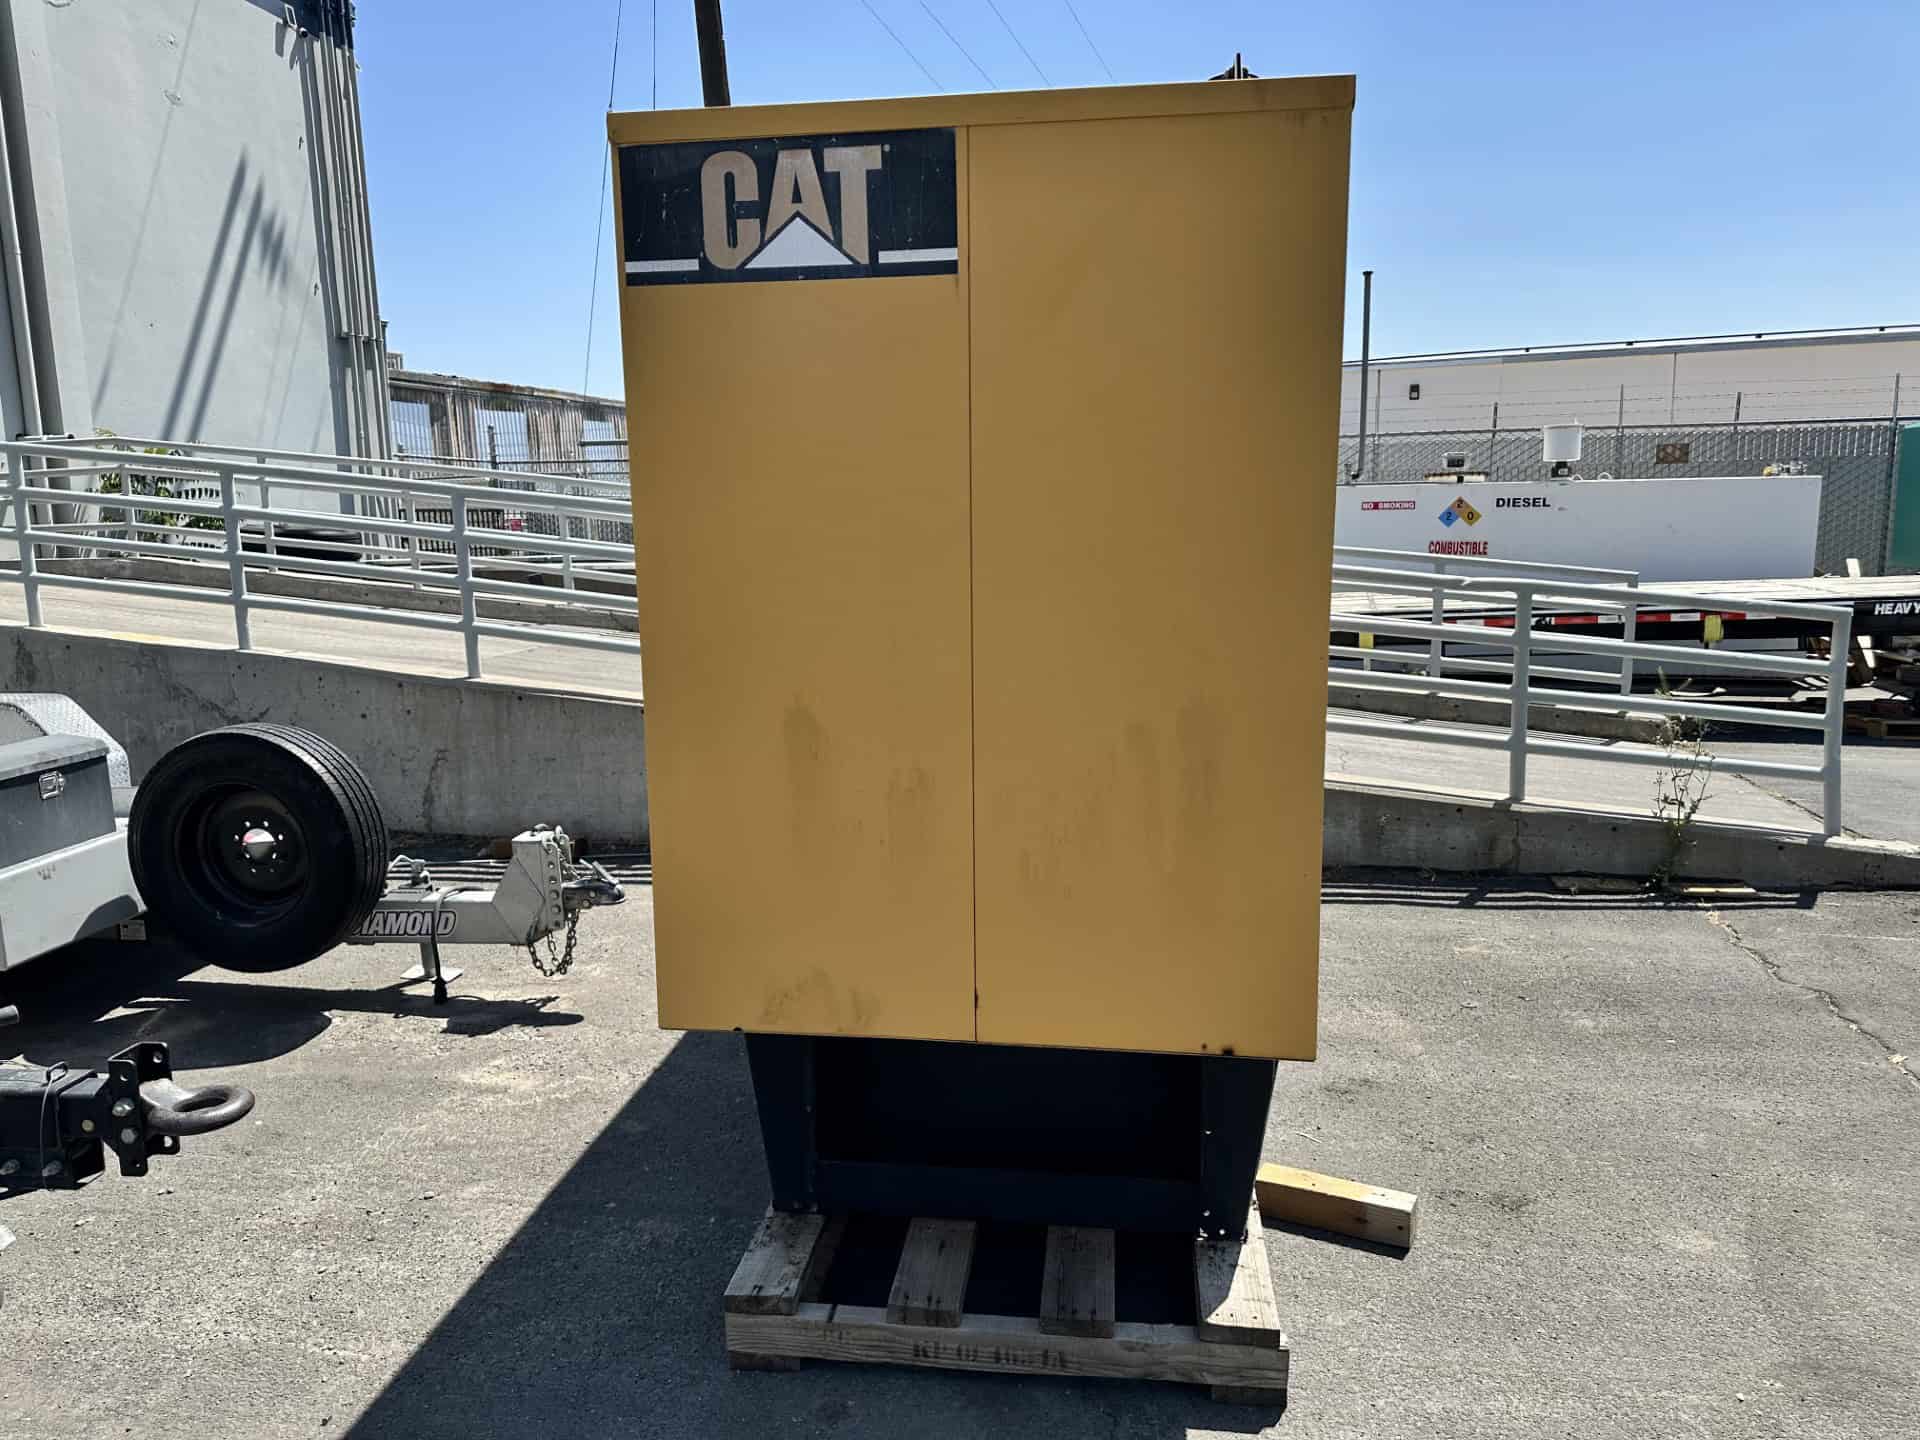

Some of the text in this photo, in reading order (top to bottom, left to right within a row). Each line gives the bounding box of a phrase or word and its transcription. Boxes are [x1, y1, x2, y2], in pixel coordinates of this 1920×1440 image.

[701, 144, 882, 270] CAT
[1495, 497, 1551, 508] DIESEL
[1445, 511, 1453, 521] 2
[1467, 511, 1474, 521] 0
[1428, 541, 1488, 556] COMBUSTIBLE
[353, 911, 456, 936] IAMOND
